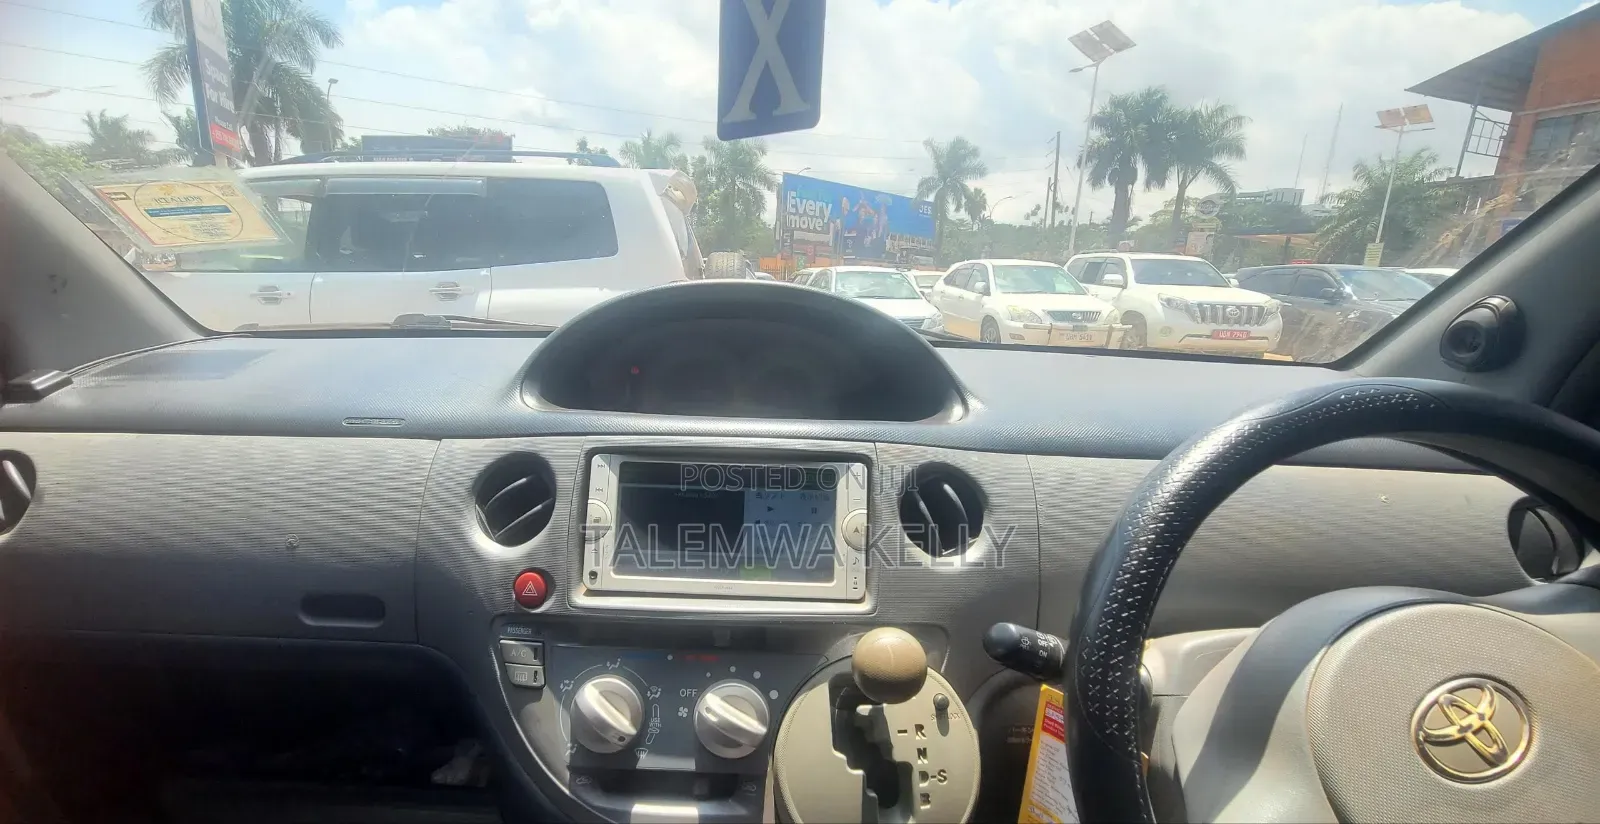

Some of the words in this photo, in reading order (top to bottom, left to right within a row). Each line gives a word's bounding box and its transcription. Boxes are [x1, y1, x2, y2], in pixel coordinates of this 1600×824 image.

[787, 190, 832, 223] Every
[786, 215, 824, 231] move
[511, 649, 527, 658] A/C
[1039, 649, 1048, 658] ON
[679, 688, 698, 698] OFF
[914, 723, 927, 740] R
[917, 747, 928, 765] N
